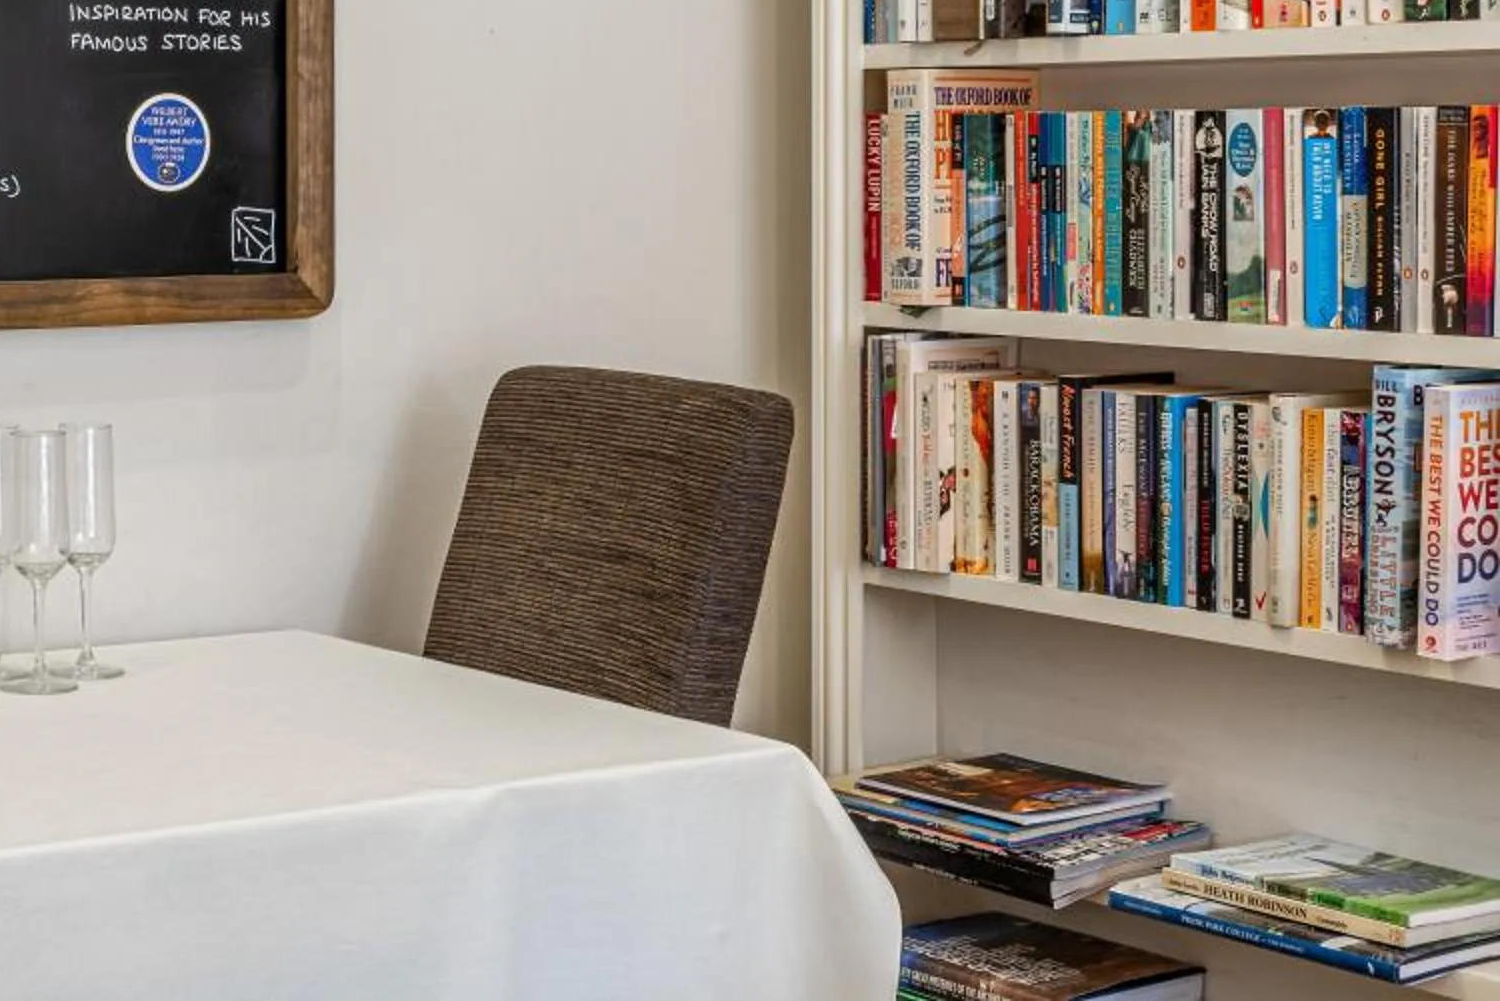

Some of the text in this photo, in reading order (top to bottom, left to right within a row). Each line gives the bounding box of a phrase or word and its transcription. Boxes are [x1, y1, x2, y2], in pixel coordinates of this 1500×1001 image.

[71, 32, 243, 52] FAMOUS STORIES
[1019, 89, 1032, 105] OF
[867, 119, 881, 212] LUCKY LUPIN
[1375, 129, 1385, 170] GONE
[905, 111, 921, 251] THE OXFORD BOOK OF
[1208, 164, 1216, 188] THE
[1375, 176, 1386, 210] GIRL
[1201, 192, 1209, 238] BANKS
[1374, 394, 1395, 495] BRYSON
[1458, 479, 1499, 512] WE
[1426, 415, 1442, 626] THE BEST WE COULD DO
[1457, 548, 1500, 584] DO
[1203, 882, 1308, 920] HEATH ROBINSON
